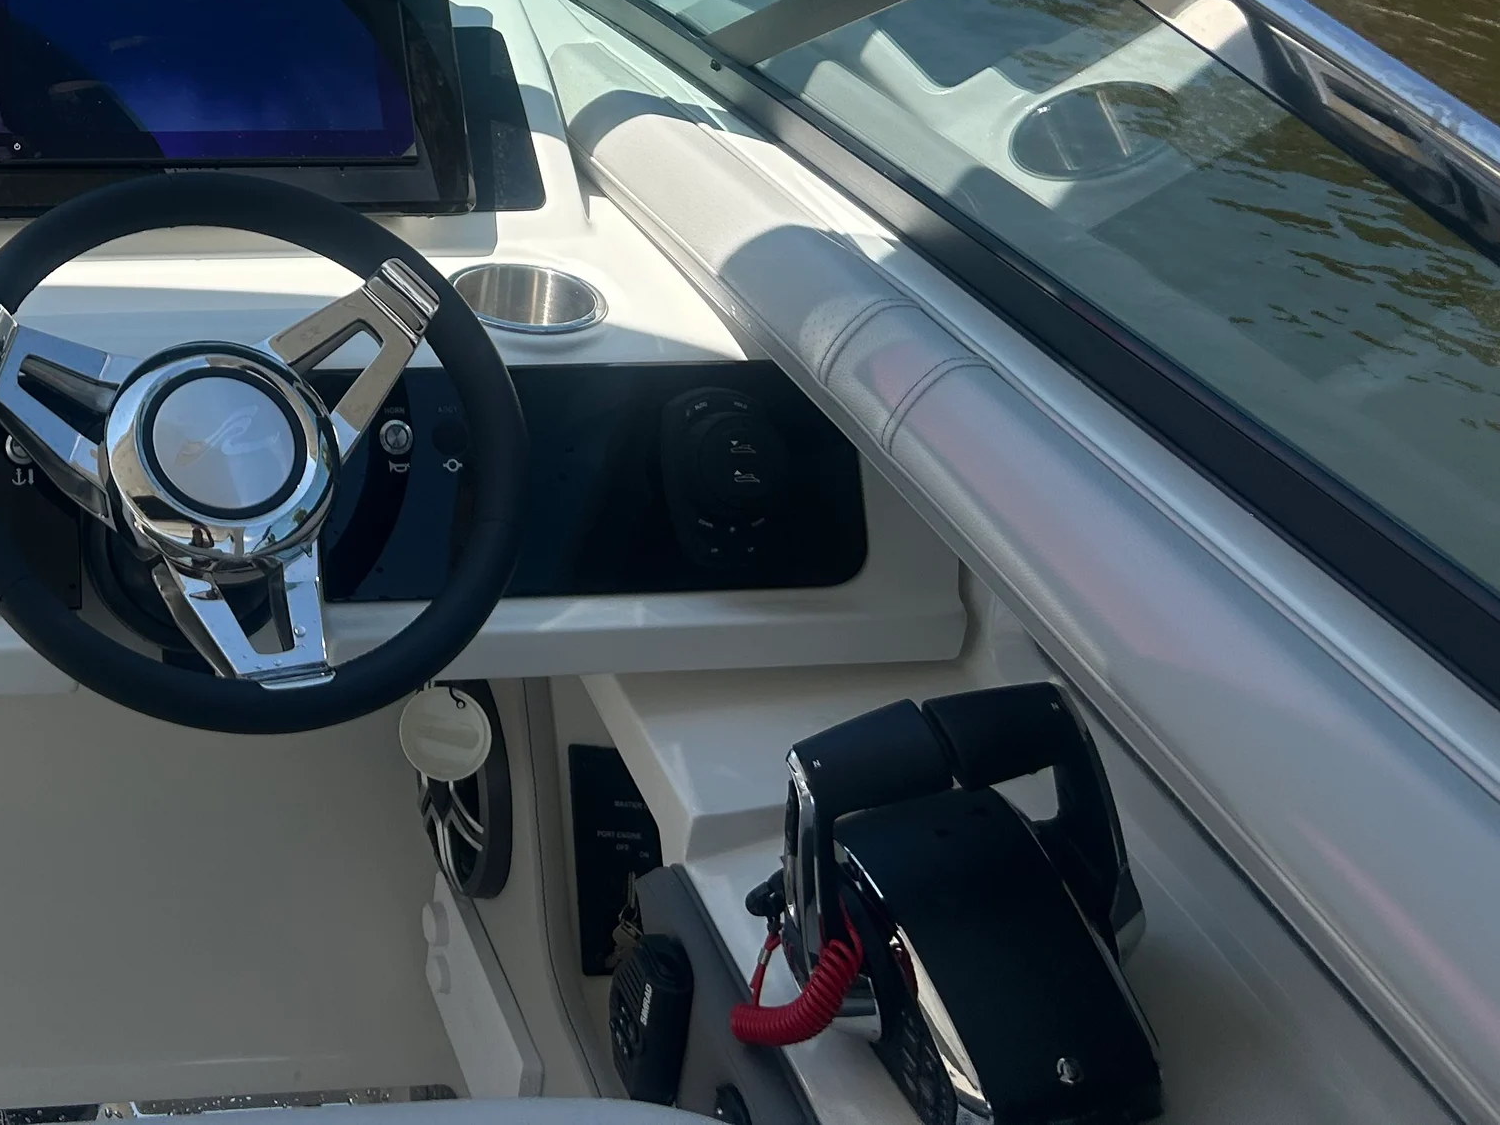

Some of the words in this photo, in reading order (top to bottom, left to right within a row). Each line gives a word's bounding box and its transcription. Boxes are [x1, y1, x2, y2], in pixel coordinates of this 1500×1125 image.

[812, 758, 822, 768] N
[614, 800, 643, 810] MASTER
[596, 830, 615, 838] PORT
[616, 831, 642, 840] ENGINE
[640, 982, 652, 1027] SIMRAD
